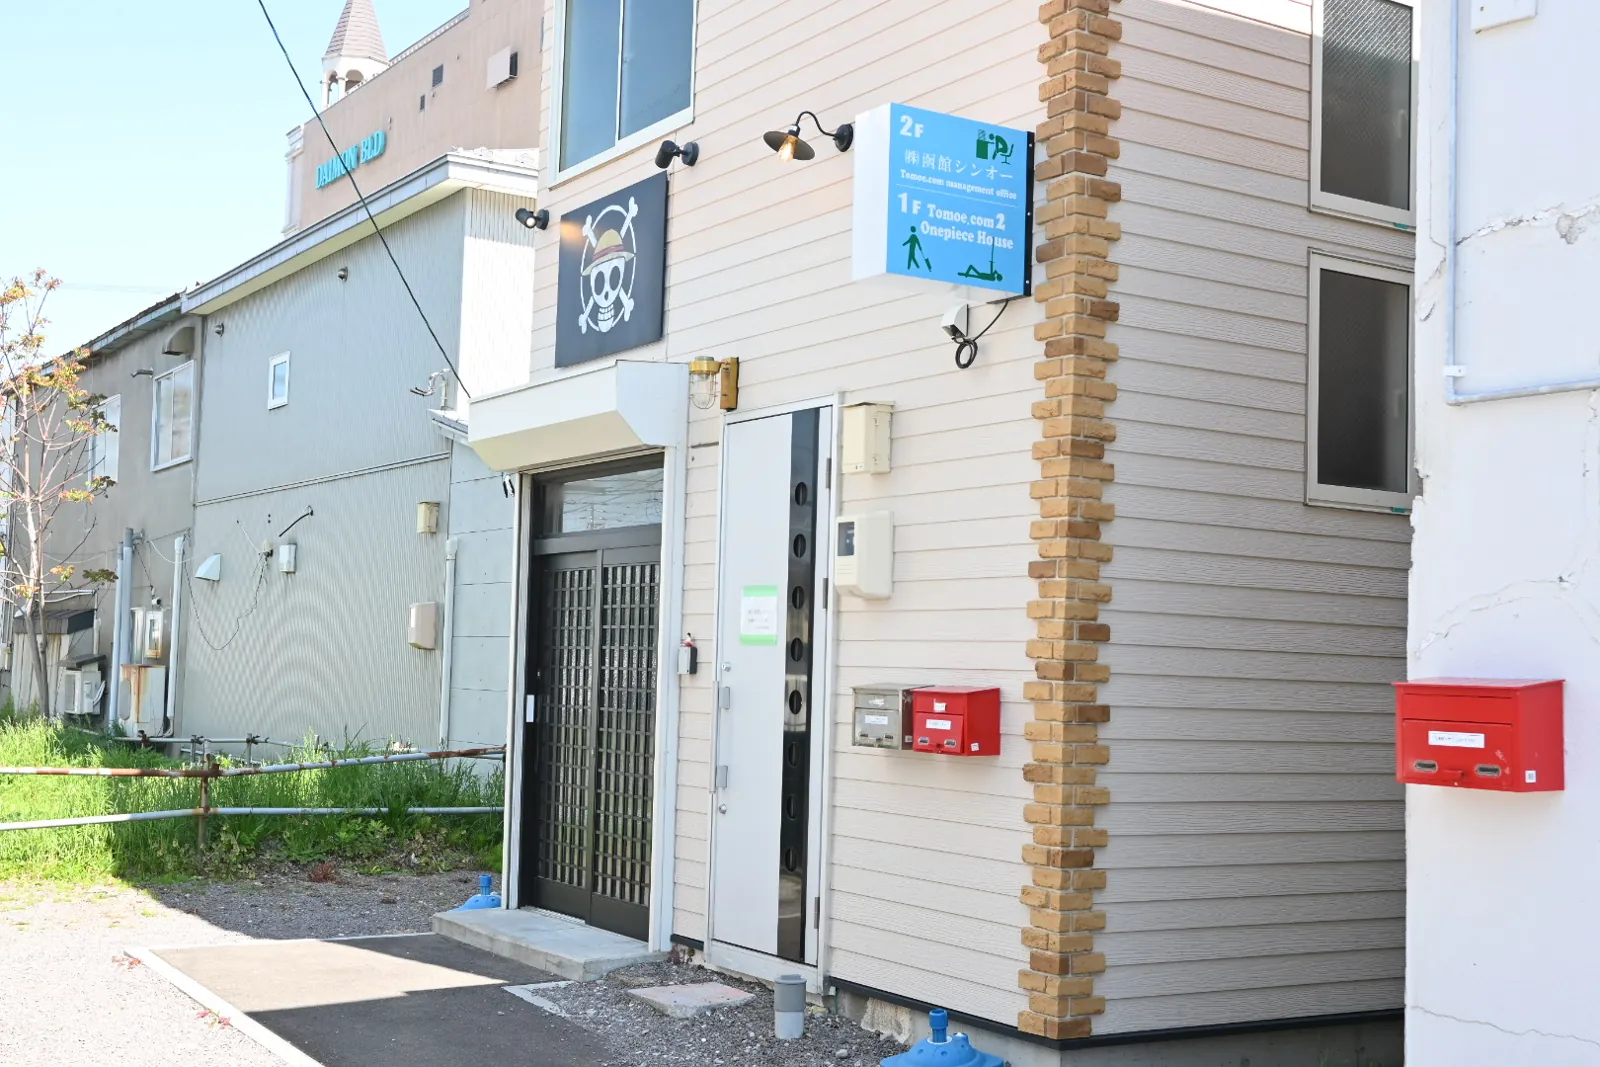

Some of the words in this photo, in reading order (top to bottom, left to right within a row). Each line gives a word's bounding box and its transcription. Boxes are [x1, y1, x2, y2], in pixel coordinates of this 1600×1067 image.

[900, 115, 924, 138] 2F
[316, 144, 359, 189] DAIMON
[900, 169, 945, 186] Tomoe.com
[945, 180, 995, 196] management
[995, 188, 1017, 200] office
[898, 193, 922, 214] 1F
[920, 220, 975, 242] Onepiece
[977, 230, 1014, 249] House
